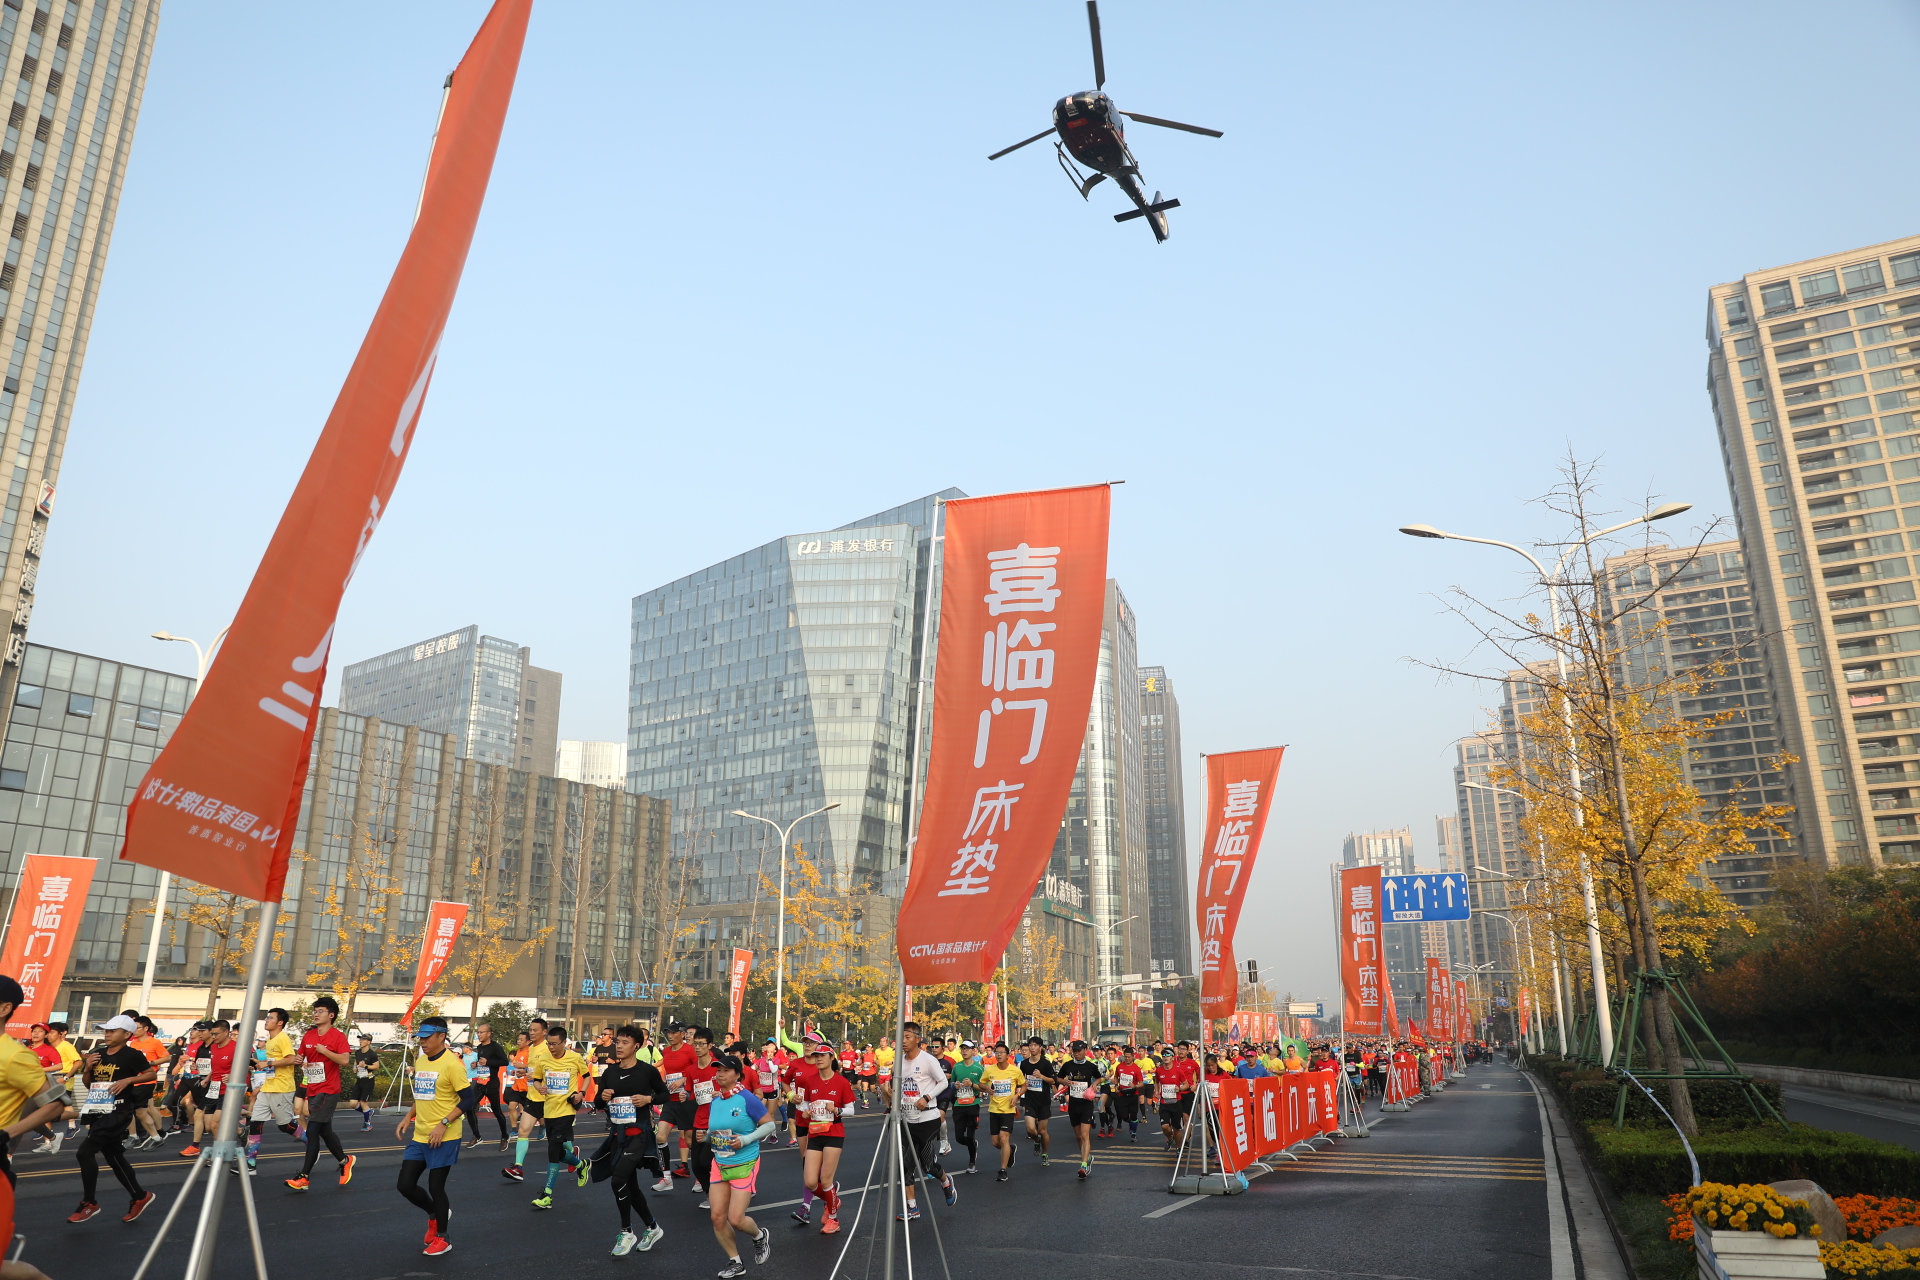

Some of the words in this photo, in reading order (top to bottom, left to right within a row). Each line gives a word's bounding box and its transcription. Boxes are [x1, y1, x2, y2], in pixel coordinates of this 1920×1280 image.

[830, 538, 894, 554] 浦发银行
[937, 542, 1062, 897] 喜临门床垫
[1202, 779, 1261, 972] 喜临门床垫
[1150, 959, 1174, 971] 集团
[1350, 884, 1379, 1007] 喜临门床垫
[546, 1078, 569, 1087] B11982
[609, 1104, 636, 1114] B31656
[1231, 1081, 1334, 1155] 喜临门床垫
